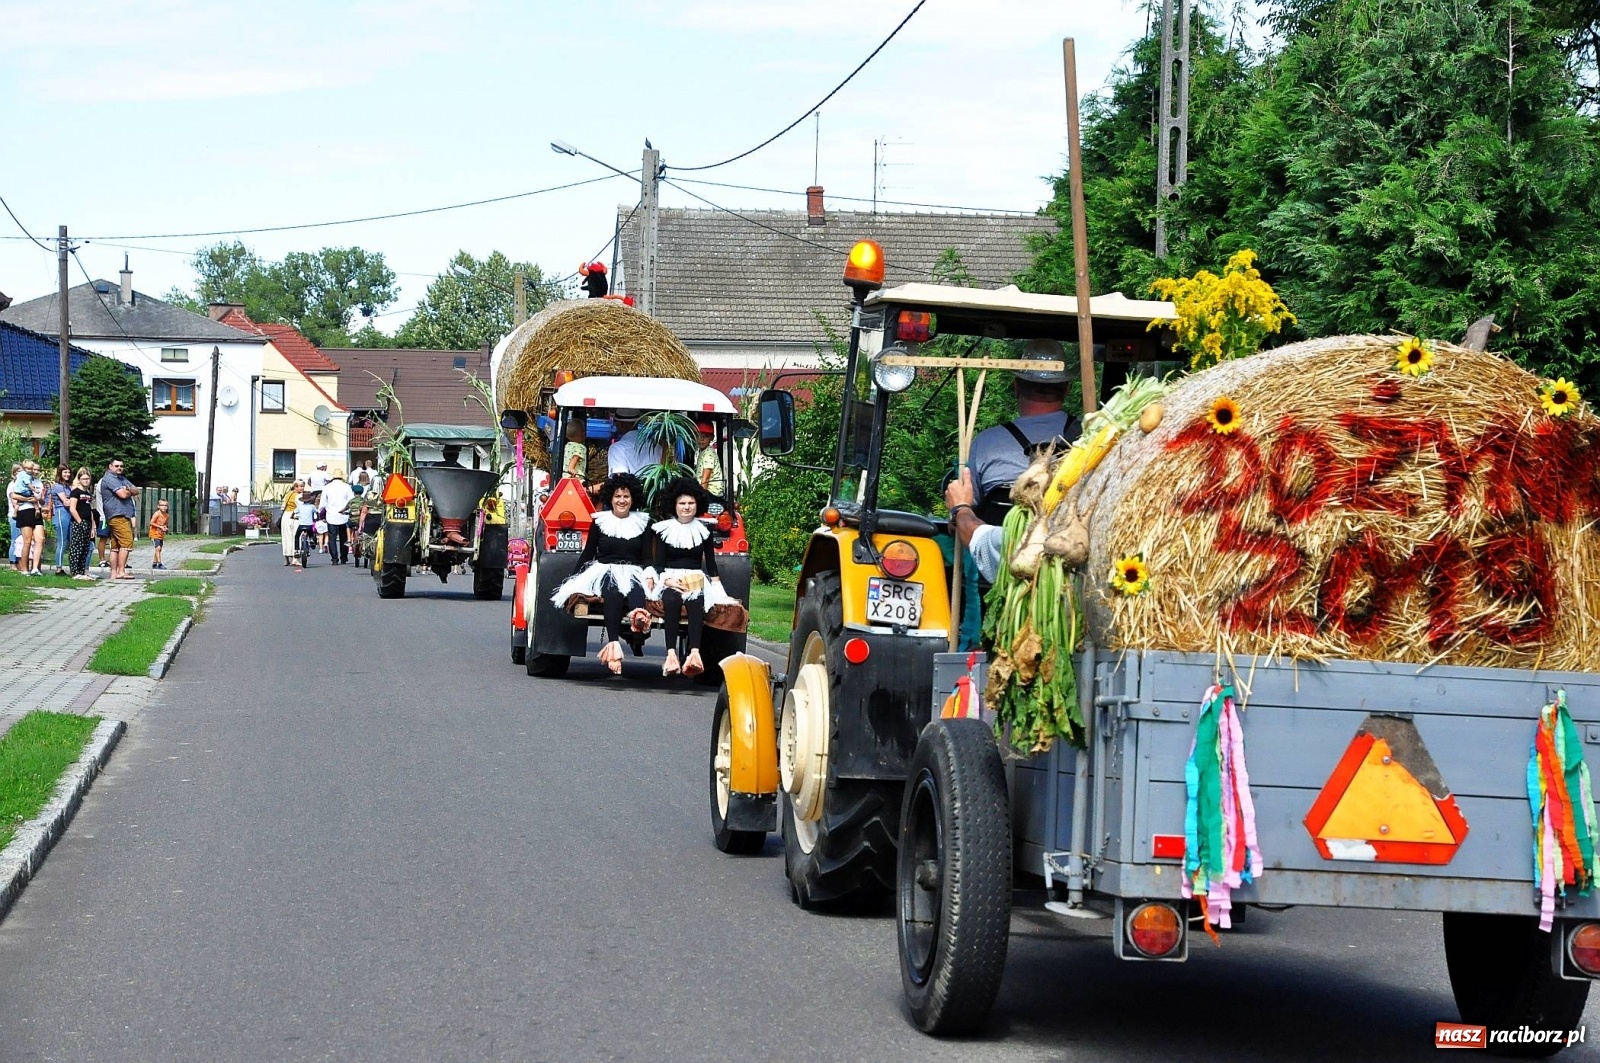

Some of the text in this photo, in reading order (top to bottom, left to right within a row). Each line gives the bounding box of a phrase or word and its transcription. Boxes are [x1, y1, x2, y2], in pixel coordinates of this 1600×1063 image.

[558, 541, 580, 549] 0708
[869, 591, 879, 599] PL
[882, 583, 914, 601] SRC
[871, 602, 917, 622] X208
